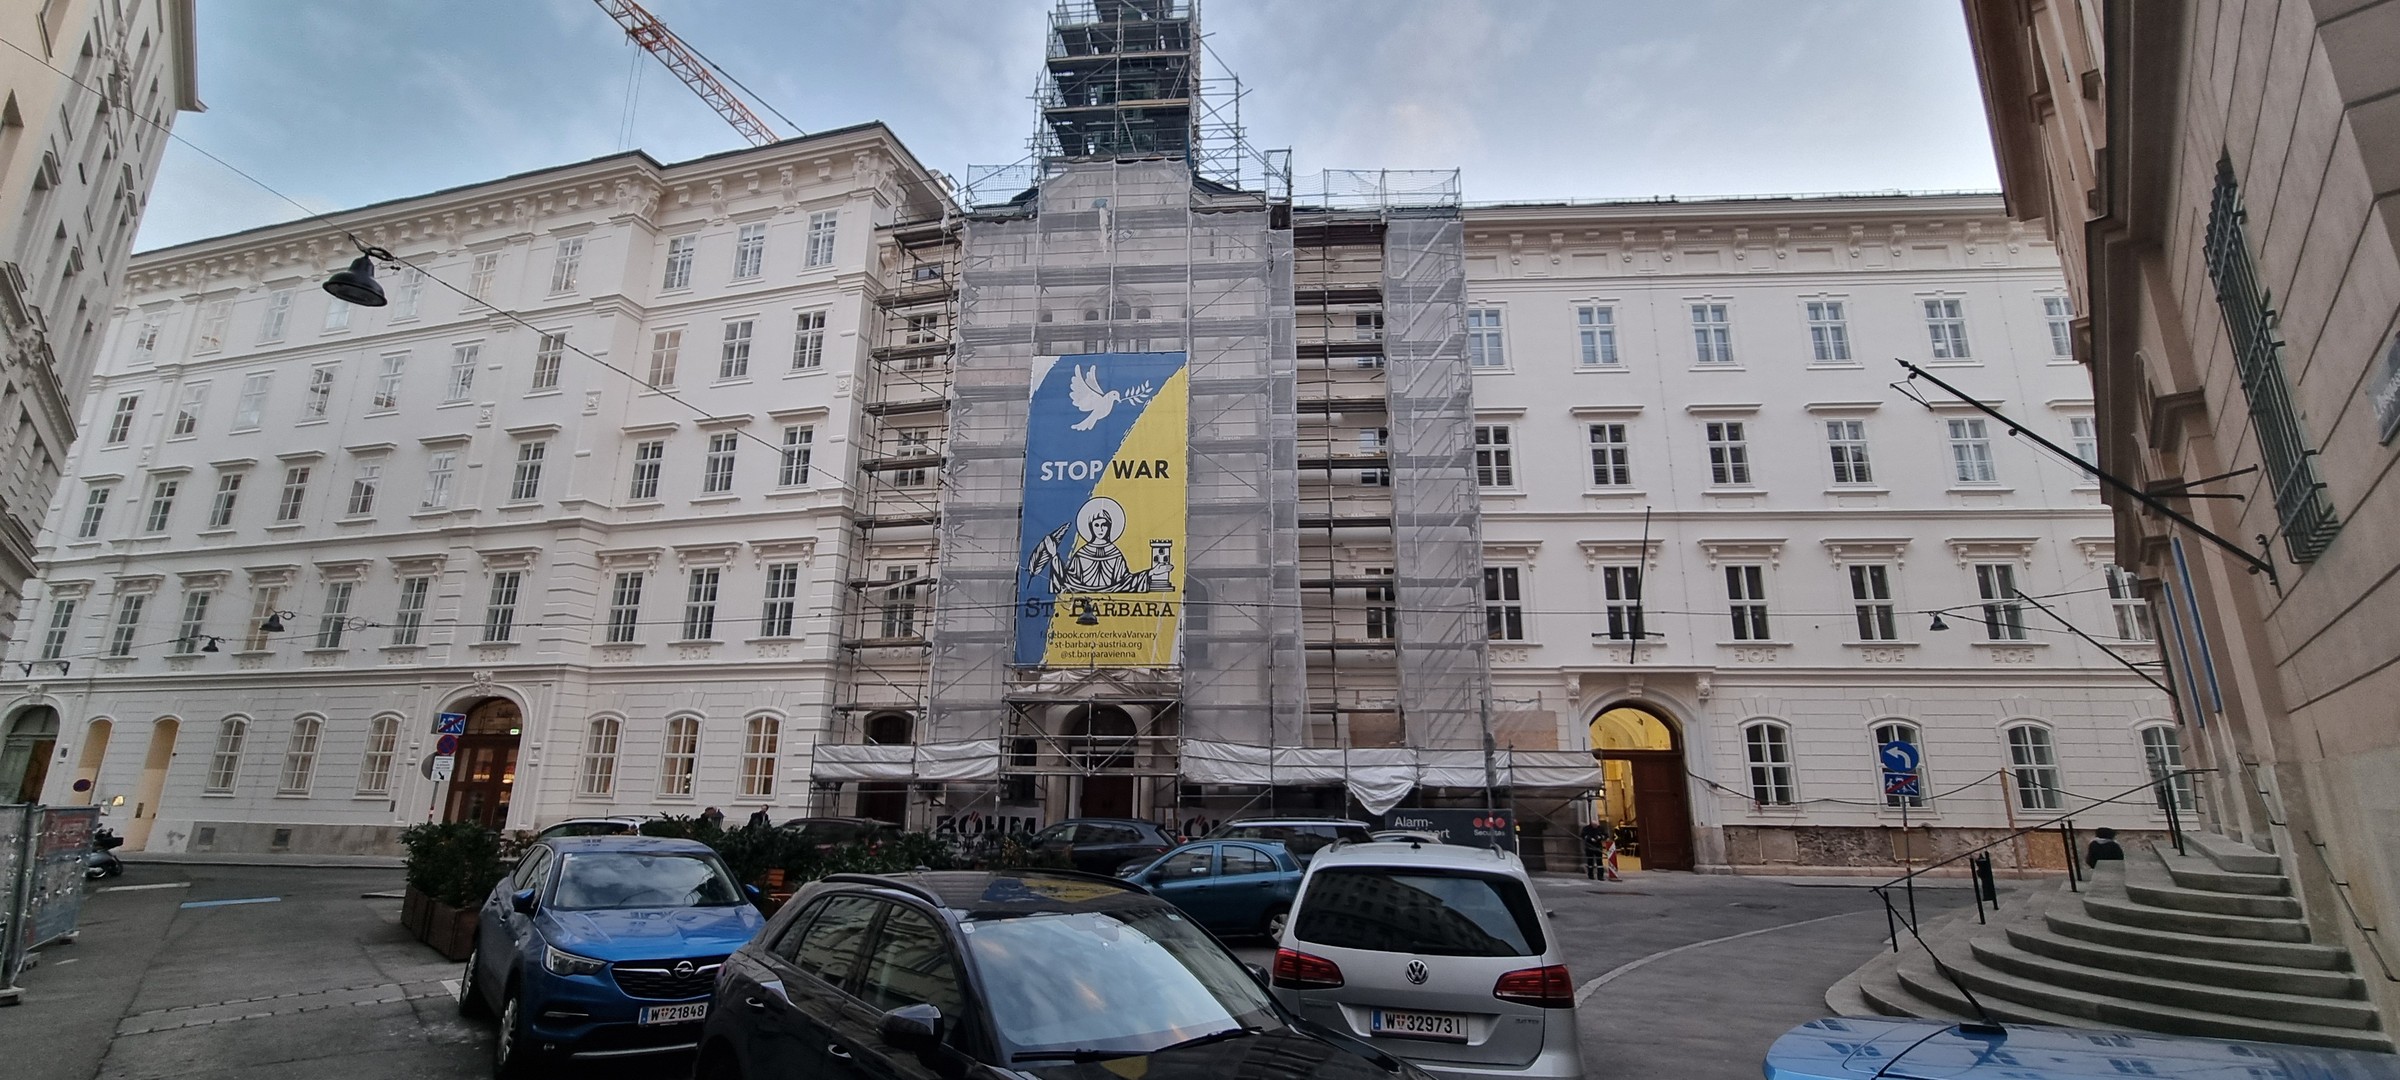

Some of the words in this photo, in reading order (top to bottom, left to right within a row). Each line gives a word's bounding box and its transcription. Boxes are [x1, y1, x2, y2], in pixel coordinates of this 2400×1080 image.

[1040, 460, 1103, 481] STOP
[1112, 459, 1170, 479] WAR
[1055, 640, 1143, 650] st-barbara-austria.org
[1394, 816, 1434, 827] Alarm-
